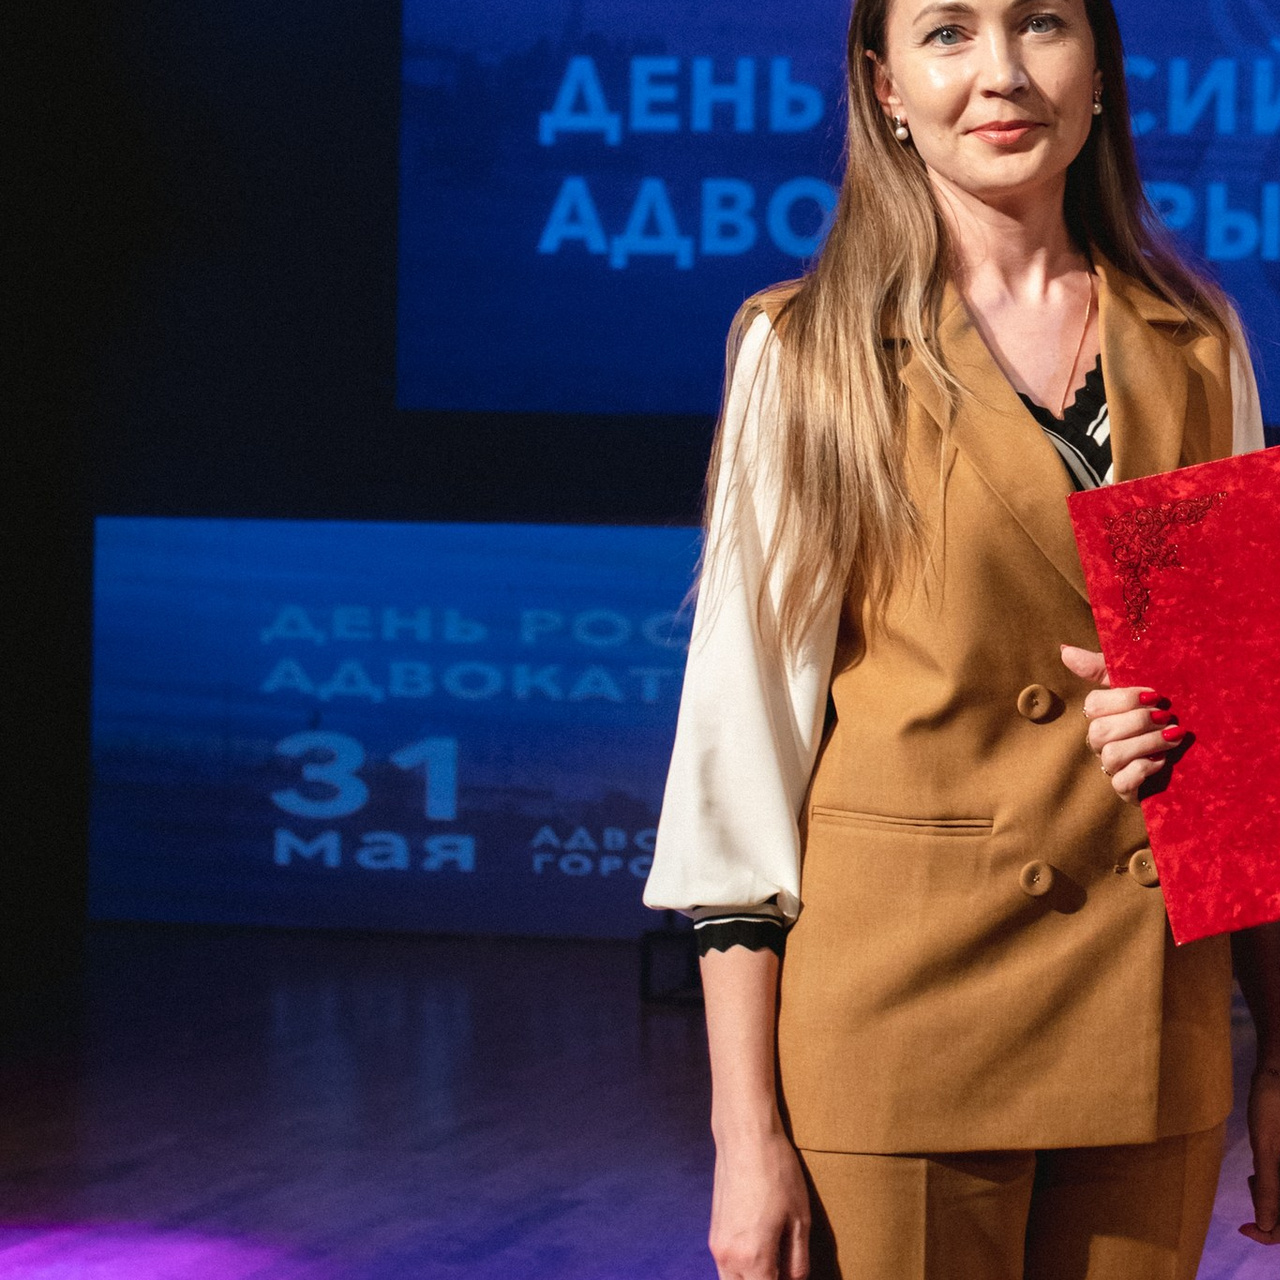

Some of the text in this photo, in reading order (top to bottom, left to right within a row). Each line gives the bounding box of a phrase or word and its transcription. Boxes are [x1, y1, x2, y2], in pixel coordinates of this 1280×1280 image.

[538, 56, 824, 145] ДЕНЬ
[260, 603, 489, 646] ДЕНЬ
[270, 730, 460, 821] 31
[273, 828, 478, 873] мая
